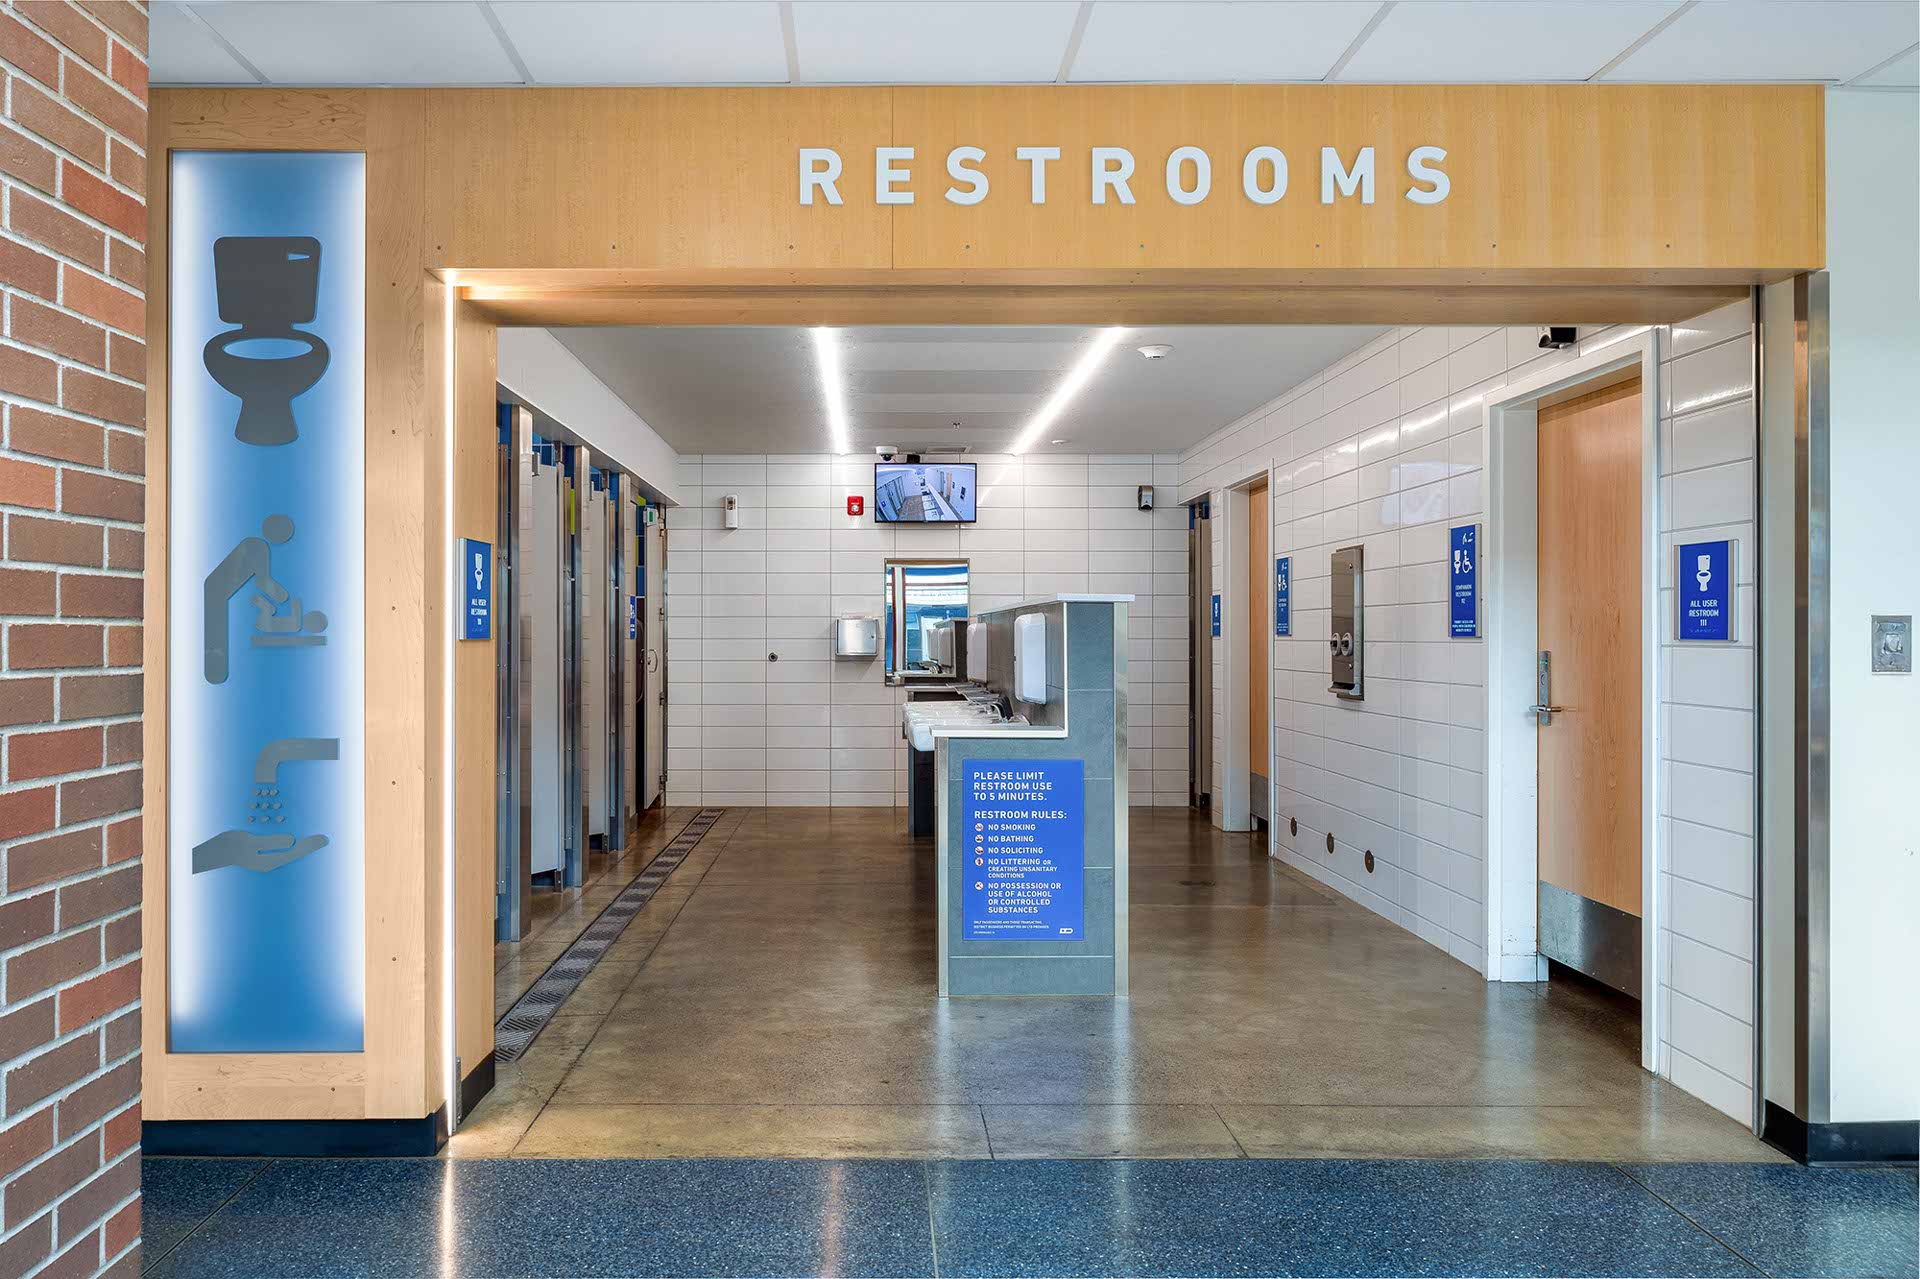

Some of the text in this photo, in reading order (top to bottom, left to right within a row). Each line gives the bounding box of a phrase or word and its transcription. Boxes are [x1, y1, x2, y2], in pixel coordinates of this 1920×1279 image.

[799, 146, 1452, 206] RESTROOMS
[1702, 599, 1718, 607] USER
[1688, 609, 1719, 617] RESTROOM
[973, 772, 1045, 780] PLEASE LIMIT
[973, 782, 1053, 790] RESTROOM USE
[973, 792, 1047, 801] TO 5 MINUTES.
[974, 811, 1067, 819] RESTROOM RULES:
